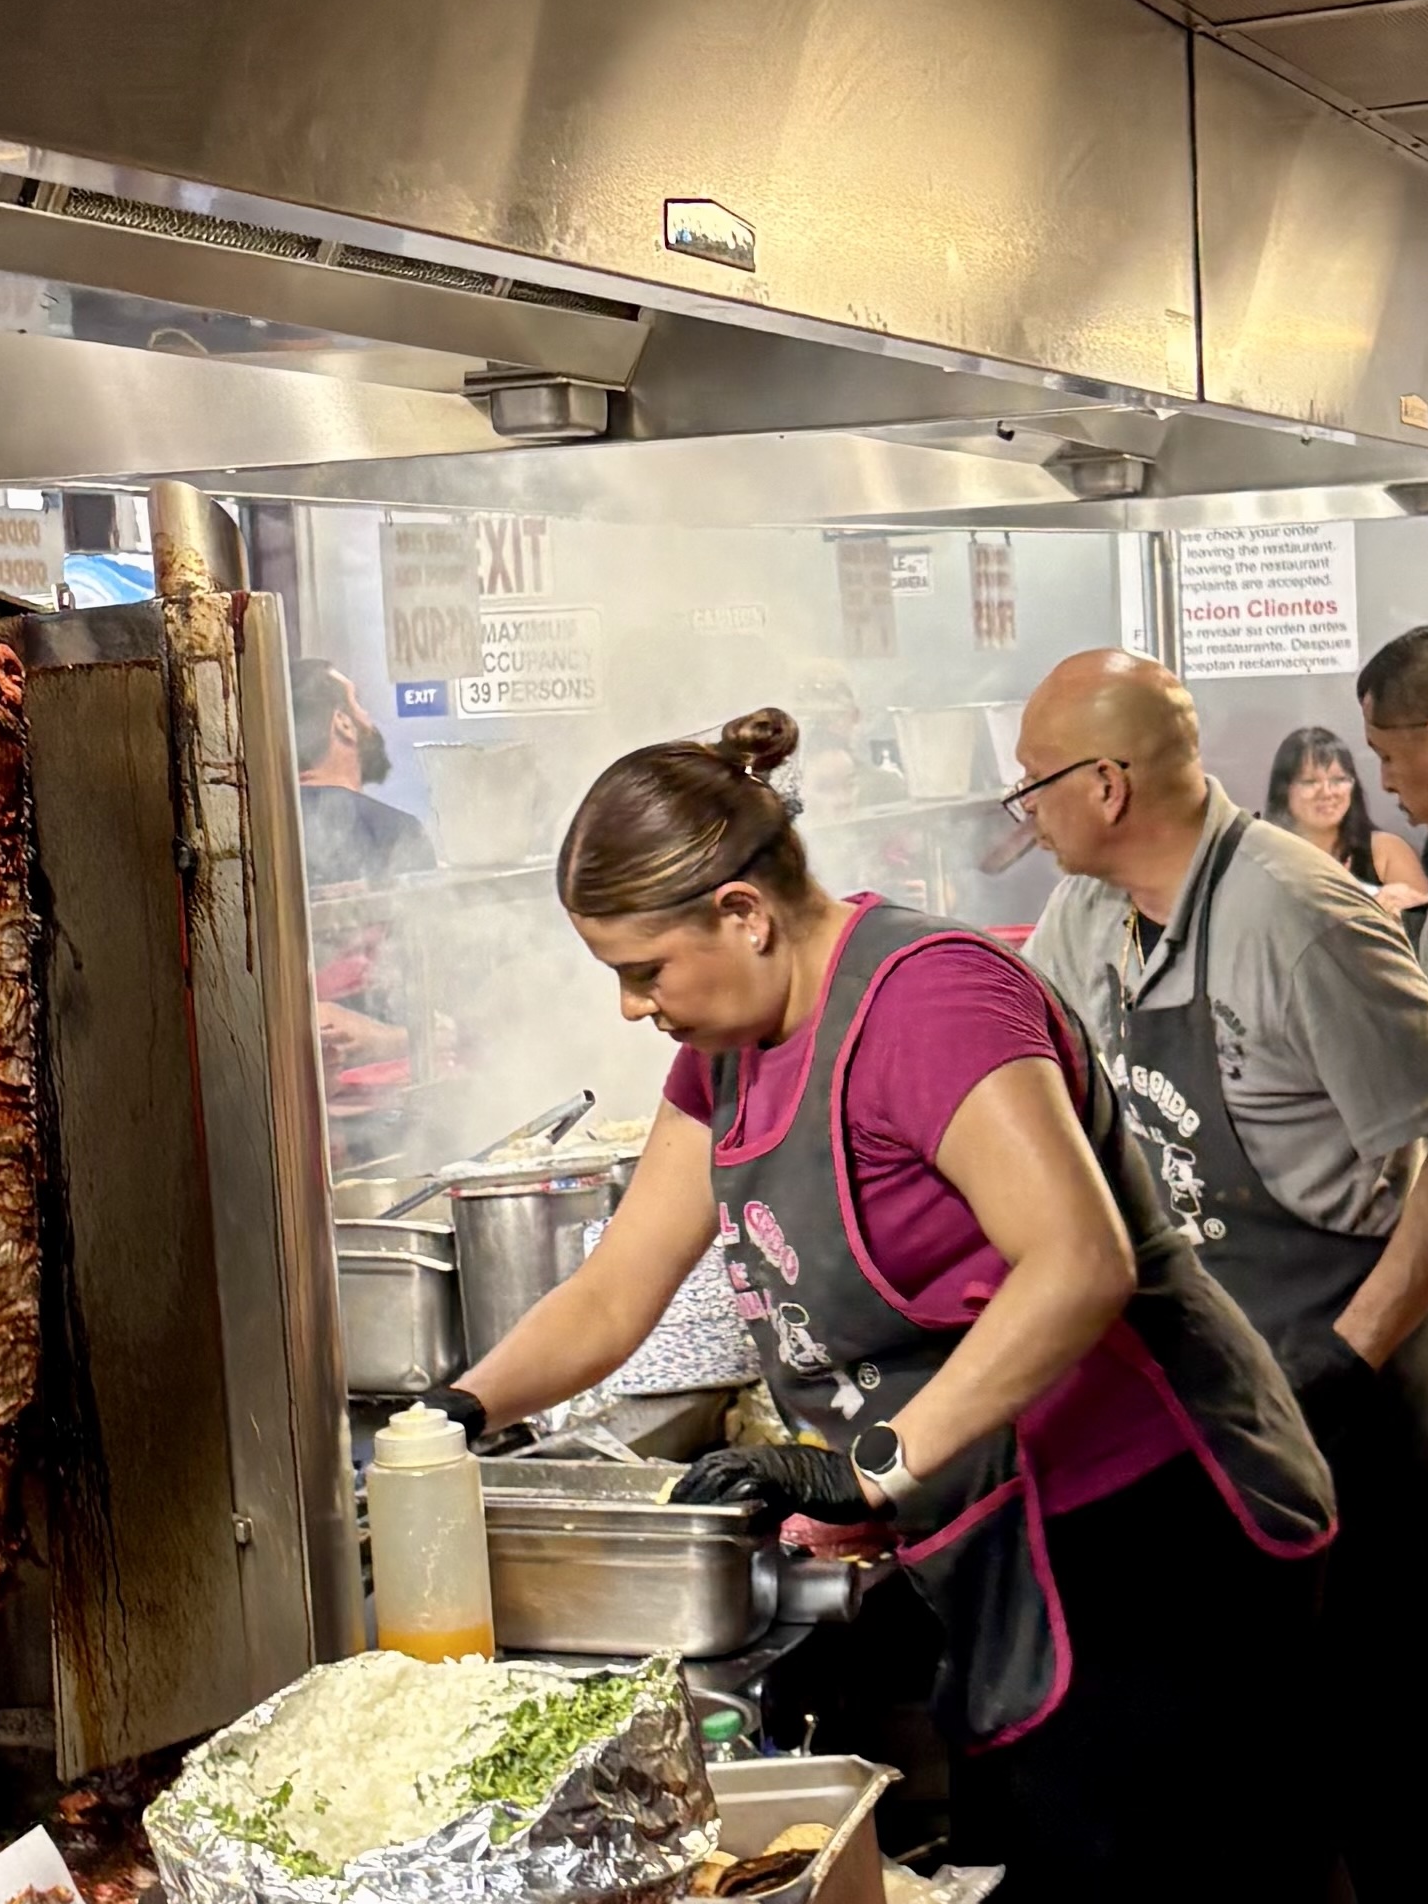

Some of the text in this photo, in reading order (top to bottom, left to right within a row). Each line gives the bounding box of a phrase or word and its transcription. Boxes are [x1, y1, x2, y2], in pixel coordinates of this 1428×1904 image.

[1206, 527, 1244, 541] check
[1249, 527, 1280, 541] your
[1283, 524, 1319, 538] order
[475, 518, 547, 594] XIT
[1187, 545, 1235, 559] leaving
[1238, 543, 1259, 556] the
[1184, 557, 1330, 576] leaving the restaurant
[1242, 580, 1263, 590] are
[1247, 598, 1338, 618] Clientes
[482, 648, 594, 674] CCUPANCY
[403, 687, 437, 705] EXIT
[469, 678, 596, 704] 39 PERSONS
